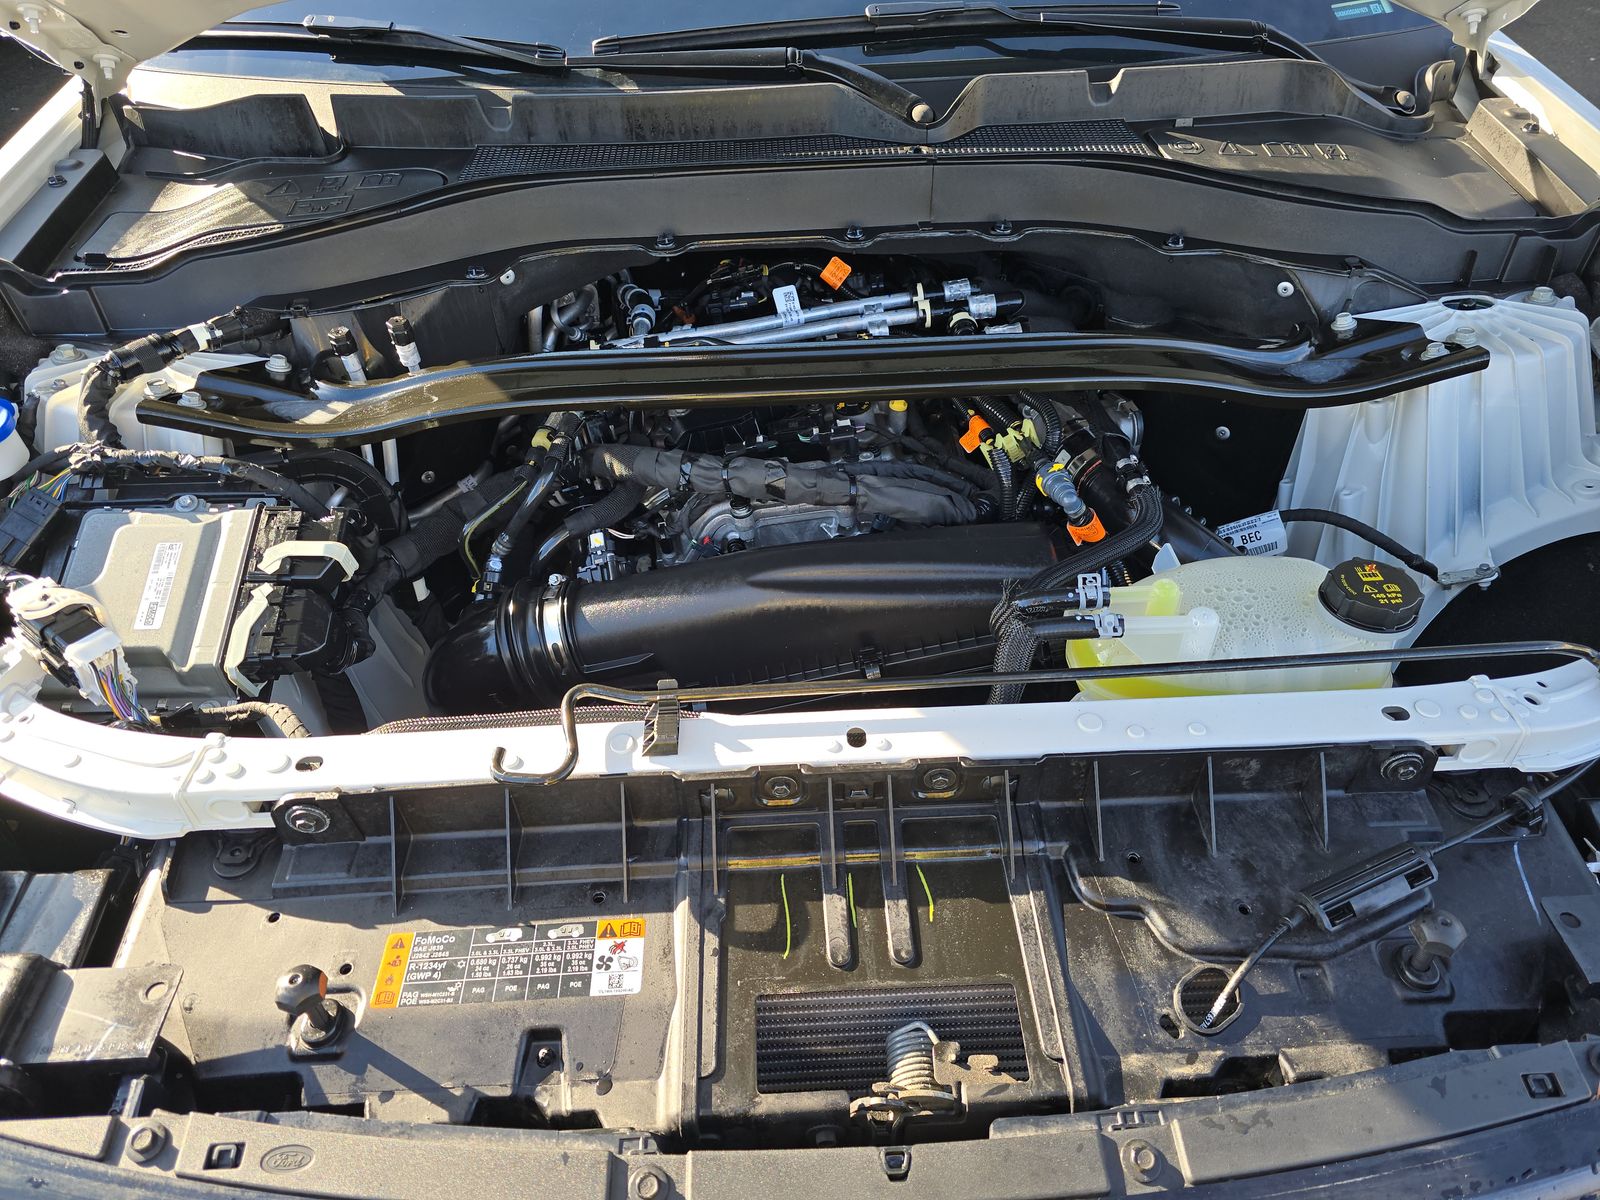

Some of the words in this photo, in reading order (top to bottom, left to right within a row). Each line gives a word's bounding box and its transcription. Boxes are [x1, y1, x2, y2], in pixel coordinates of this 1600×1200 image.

[1240, 530, 1262, 545] BEC
[415, 935, 456, 945] FoMoCo
[502, 956, 519, 964] 0.737
[519, 955, 528, 964] kg
[553, 953, 561, 961] kg
[566, 952, 583, 960] 0.992
[583, 951, 592, 960] kg
[409, 960, 447, 971] R-1234yf
[488, 957, 497, 966] kg
[406, 972, 431, 982] (GWP
[432, 971, 441, 980] 4)
[471, 986, 485, 994] PAG
[504, 984, 518, 992] POE
[536, 982, 550, 990] PAG
[402, 991, 419, 999] PAG
[400, 998, 417, 1006] POE
[273, 1152, 305, 1168] Ford
